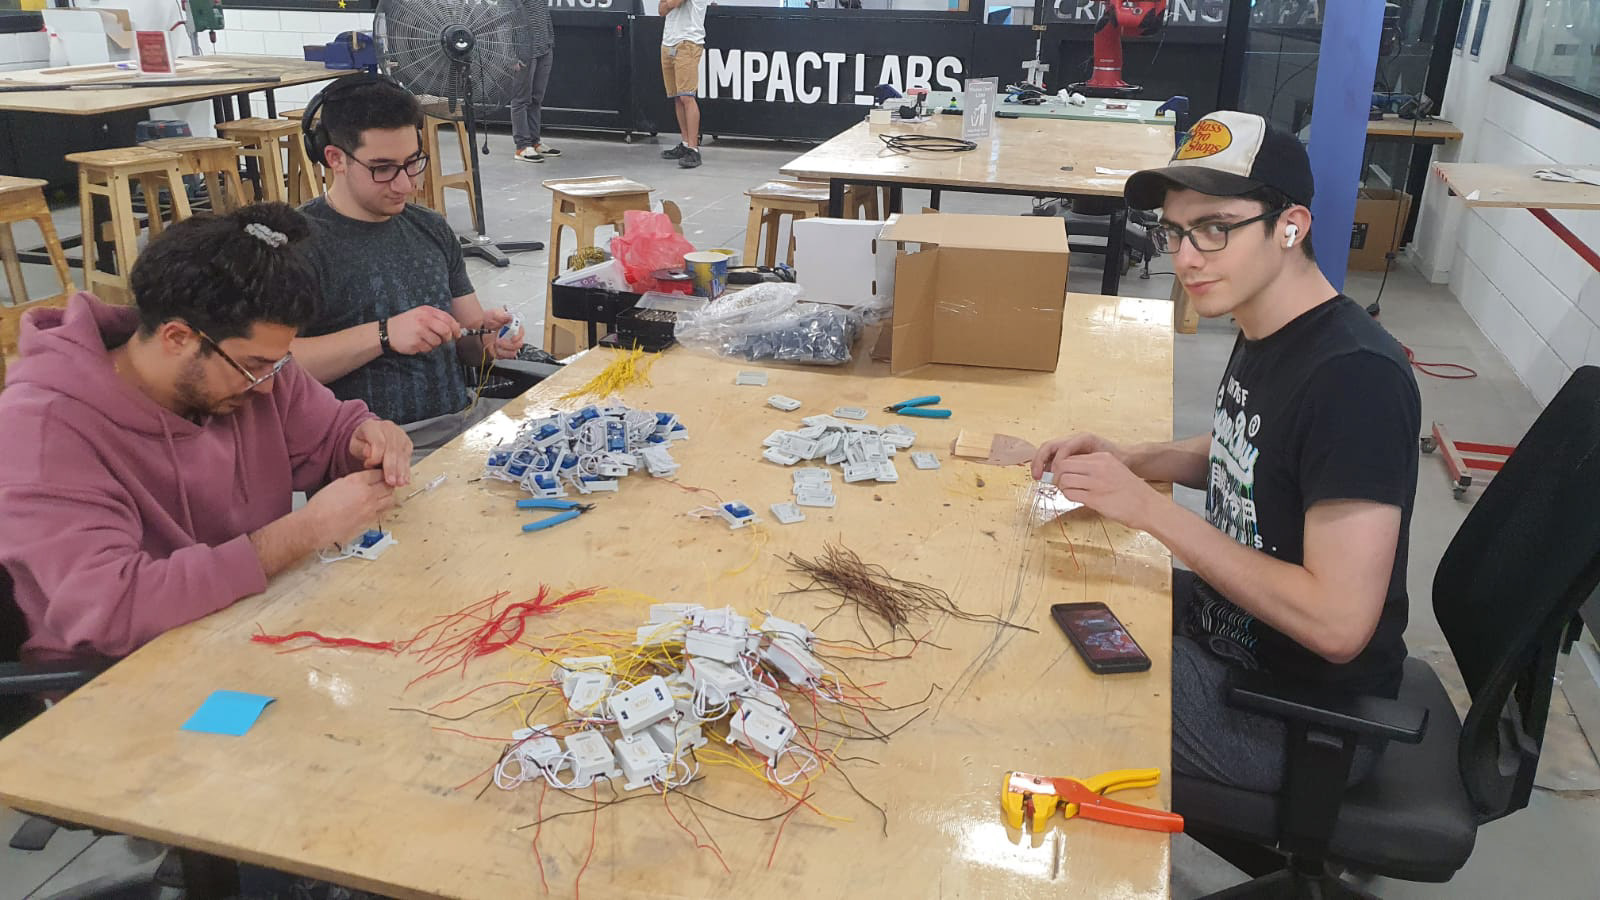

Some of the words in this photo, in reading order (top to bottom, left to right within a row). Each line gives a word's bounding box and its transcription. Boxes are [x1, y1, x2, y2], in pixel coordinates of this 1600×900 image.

[698, 48, 846, 105] IMPACT
[855, 53, 963, 105] LABS
[1196, 121, 1224, 133] Bass
[1191, 129, 1211, 141] Pro
[1185, 140, 1222, 155] Shops
